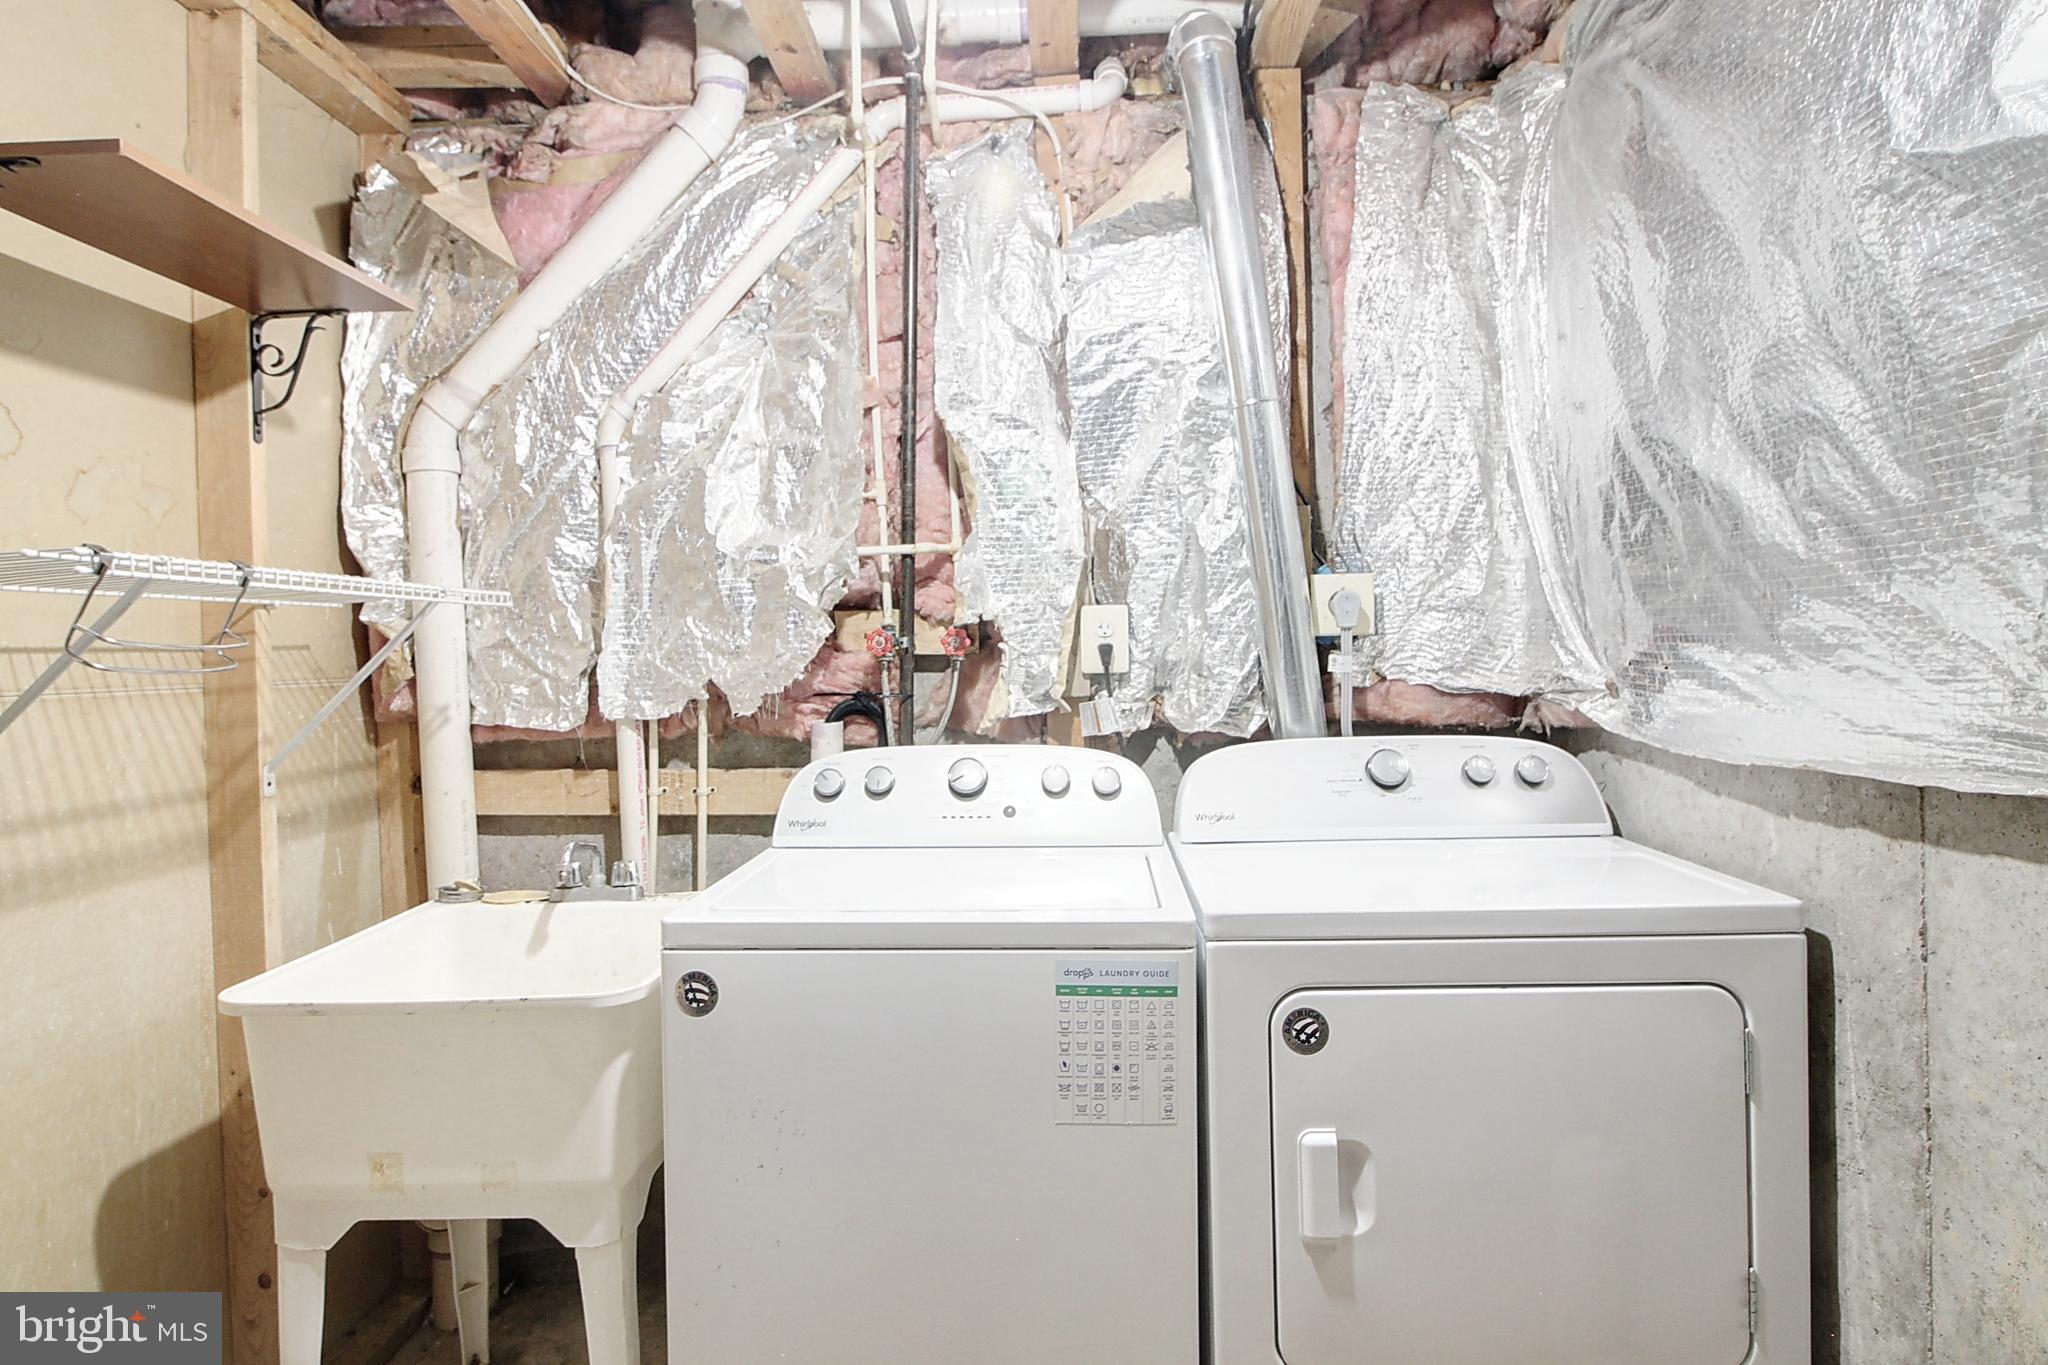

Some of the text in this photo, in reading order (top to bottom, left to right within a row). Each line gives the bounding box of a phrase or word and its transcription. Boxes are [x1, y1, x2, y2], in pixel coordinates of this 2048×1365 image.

[787, 818, 827, 831] Whirlpool
[1195, 812, 1235, 825] Whirlpool
[1099, 969, 1140, 978] LAUNDRY
[1143, 969, 1171, 978] GUIDE
[682, 971, 718, 998] AMERICA
[1284, 1009, 1321, 1035] AMERICA
